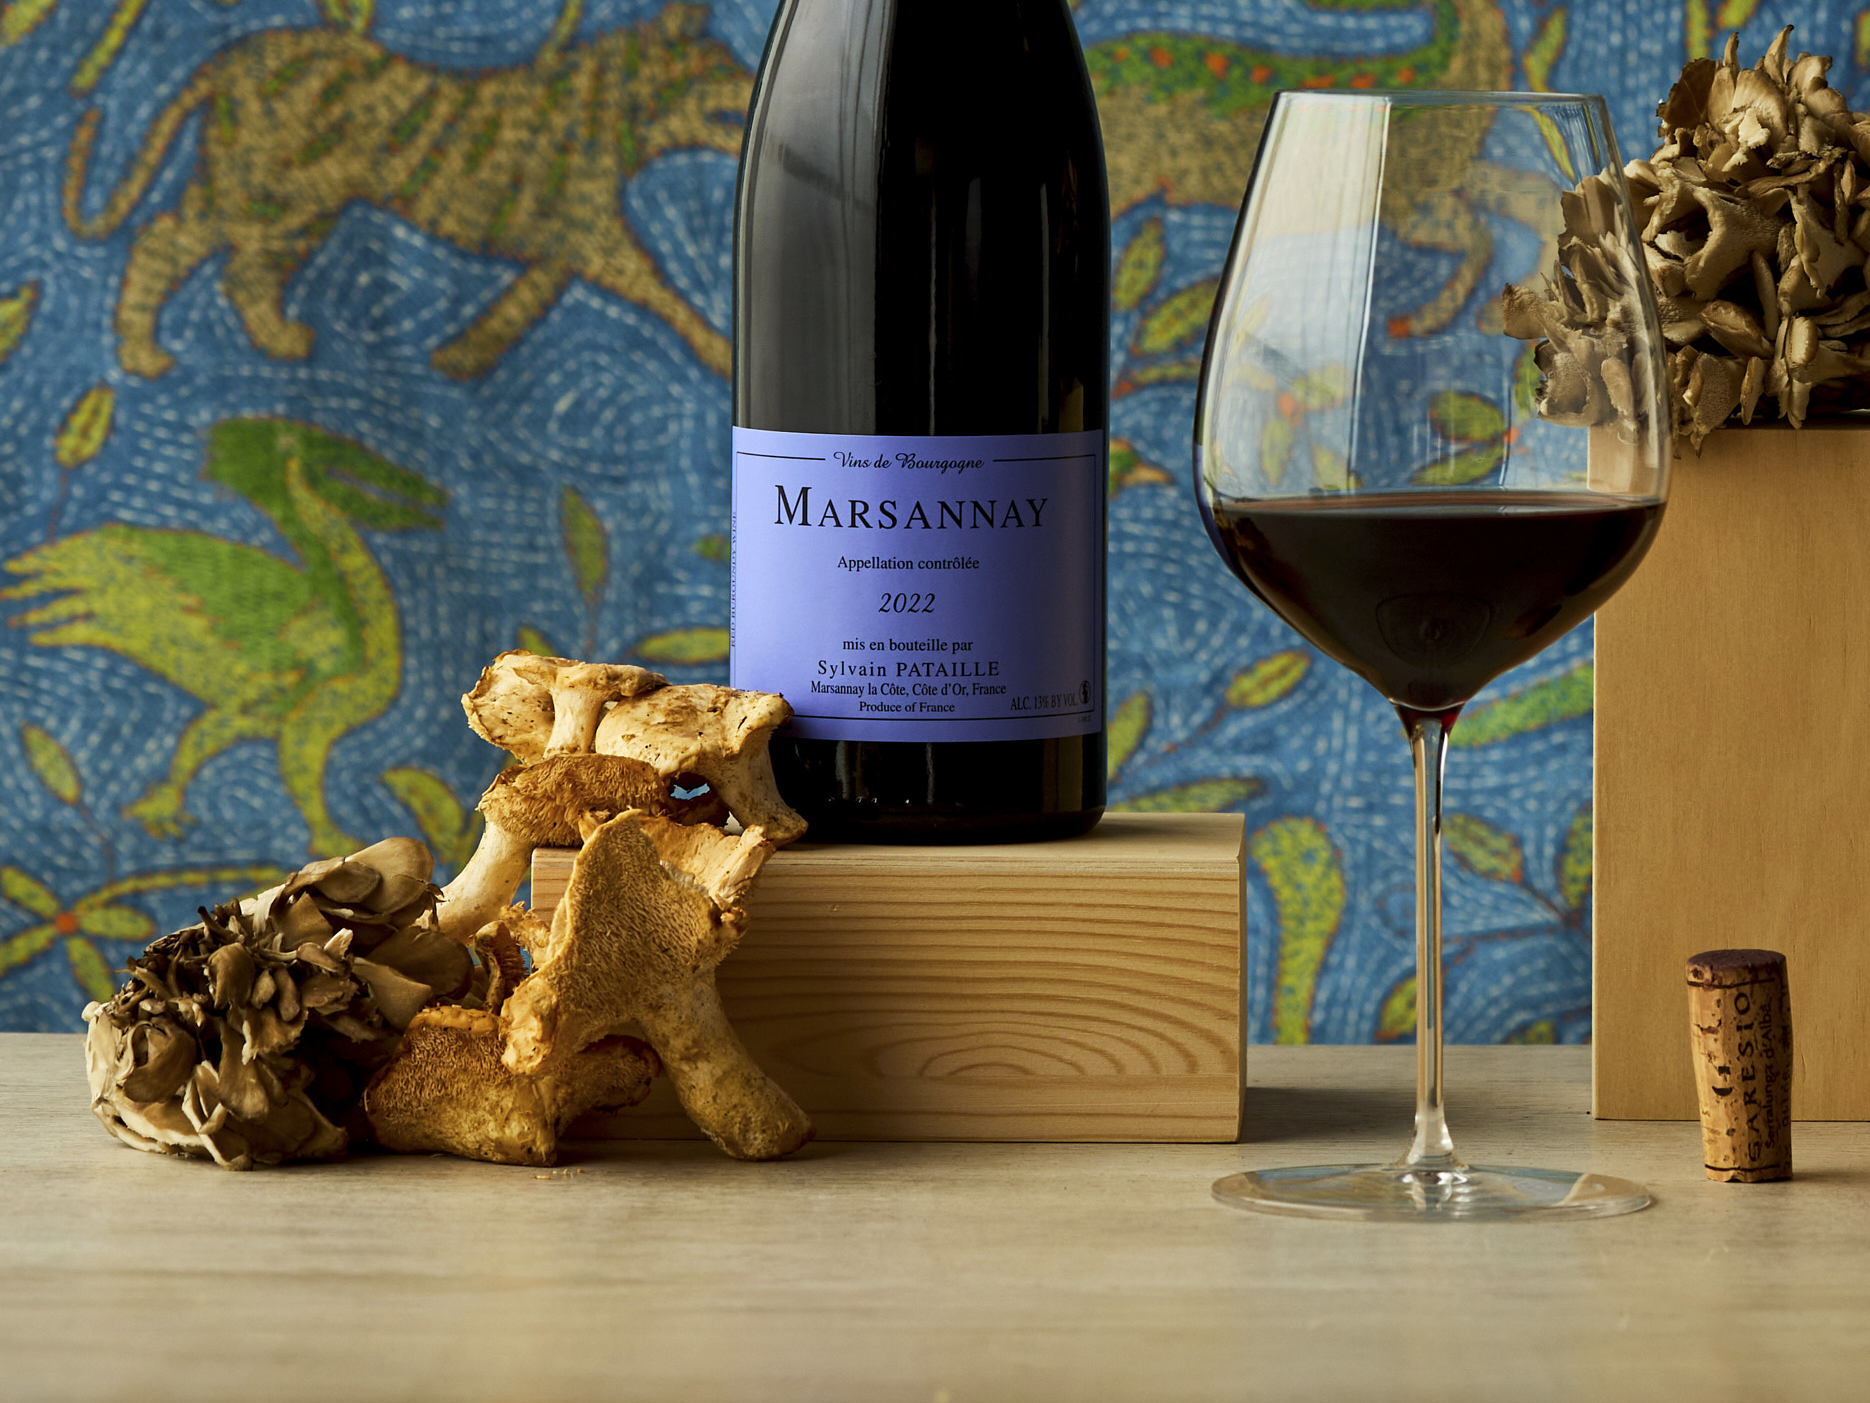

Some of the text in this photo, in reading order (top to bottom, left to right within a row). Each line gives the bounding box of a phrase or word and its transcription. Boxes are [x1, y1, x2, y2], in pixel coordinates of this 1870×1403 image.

[833, 451, 985, 475] Vins de Bourgogne
[837, 555, 981, 571] Appellation contrôlée
[878, 592, 937, 614] 2022
[842, 637, 974, 655] mis en bouteille par
[817, 659, 1000, 679] Sylvain PATAILLE
[810, 681, 865, 698] Marsannay
[867, 681, 878, 695] la
[880, 680, 910, 697] Côte,
[912, 680, 939, 696] Côte
[972, 682, 1007, 696] France
[859, 701, 956, 713] Produce of France
[1010, 696, 1032, 711] ALC.
[1034, 695, 1050, 710] 13%
[1051, 694, 1063, 708] BY
[1733, 991, 1762, 1162] GARESIO
[1763, 1063, 1778, 1149] Serralunga
